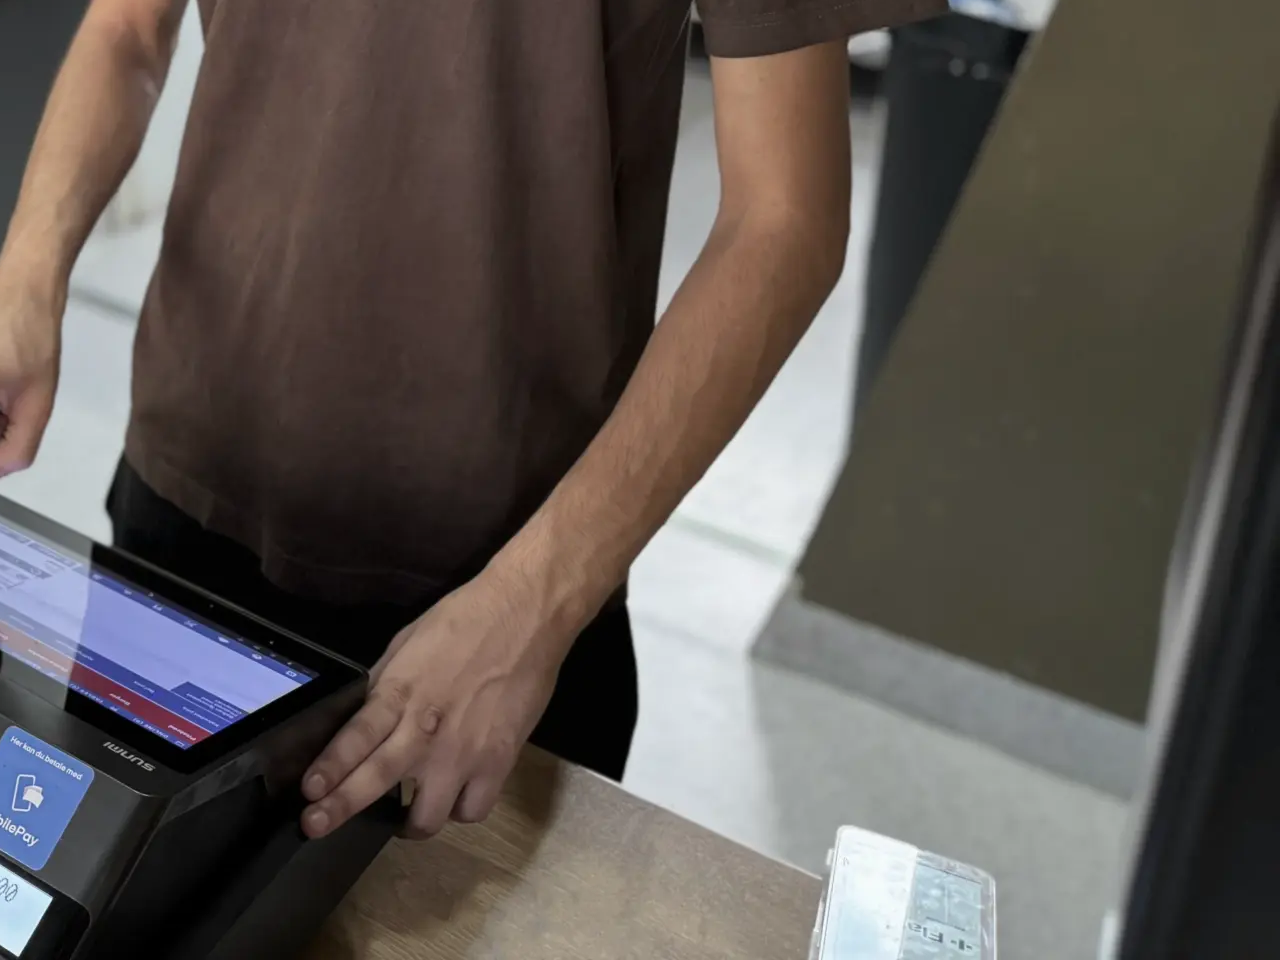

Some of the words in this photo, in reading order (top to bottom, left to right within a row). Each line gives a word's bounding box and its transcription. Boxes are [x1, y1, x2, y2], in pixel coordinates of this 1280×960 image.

[10, 736, 24, 748] Her
[22, 742, 36, 755] kan
[35, 750, 46, 760] du
[44, 755, 66, 772] betale
[65, 768, 84, 781] med
